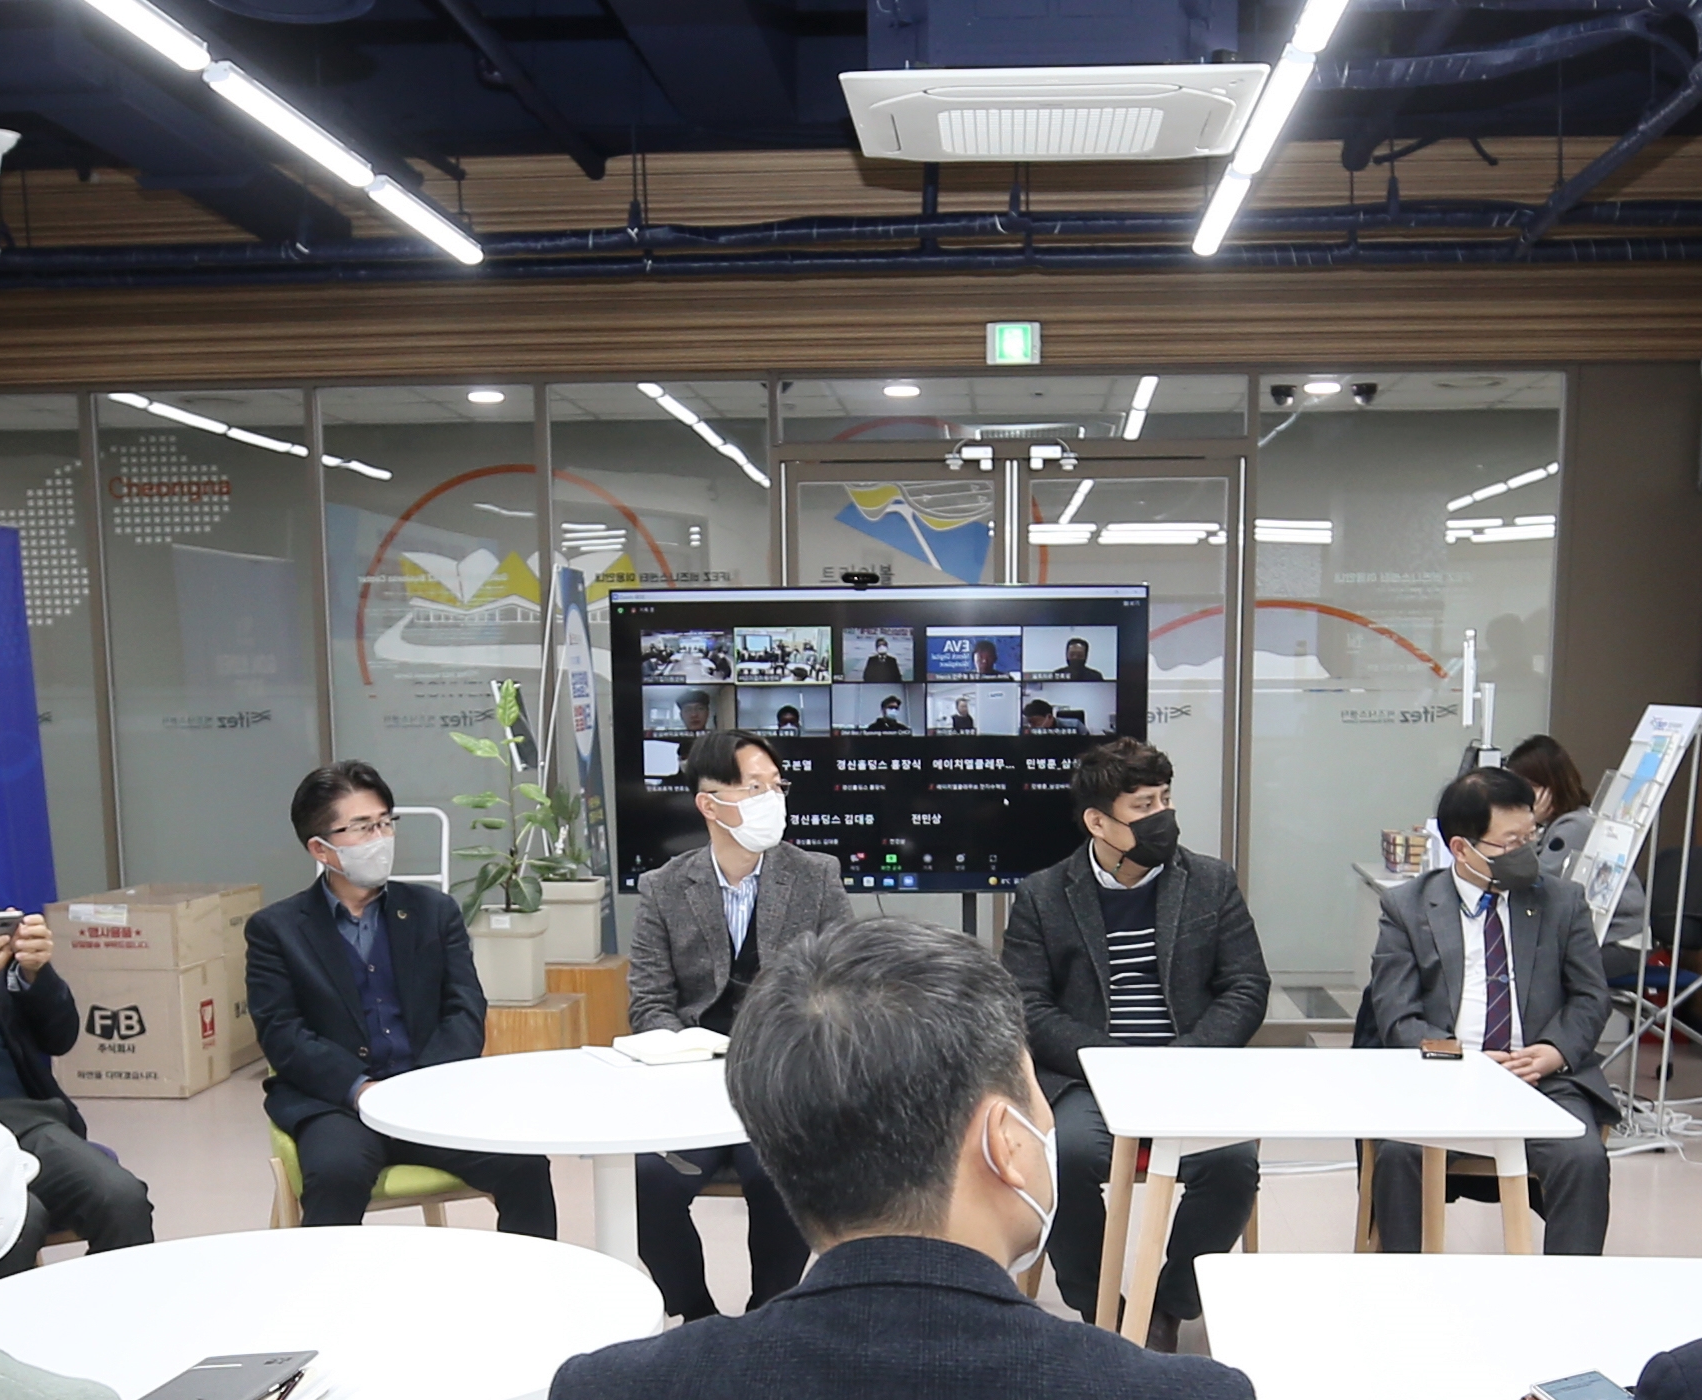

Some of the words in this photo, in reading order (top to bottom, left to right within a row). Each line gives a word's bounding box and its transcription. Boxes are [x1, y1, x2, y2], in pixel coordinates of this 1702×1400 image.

[108, 476, 233, 503] Cheongna
[836, 759, 888, 771] 경신홀딩스
[789, 813, 841, 826] 경신홀딩스
[93, 1009, 142, 1036] FB
